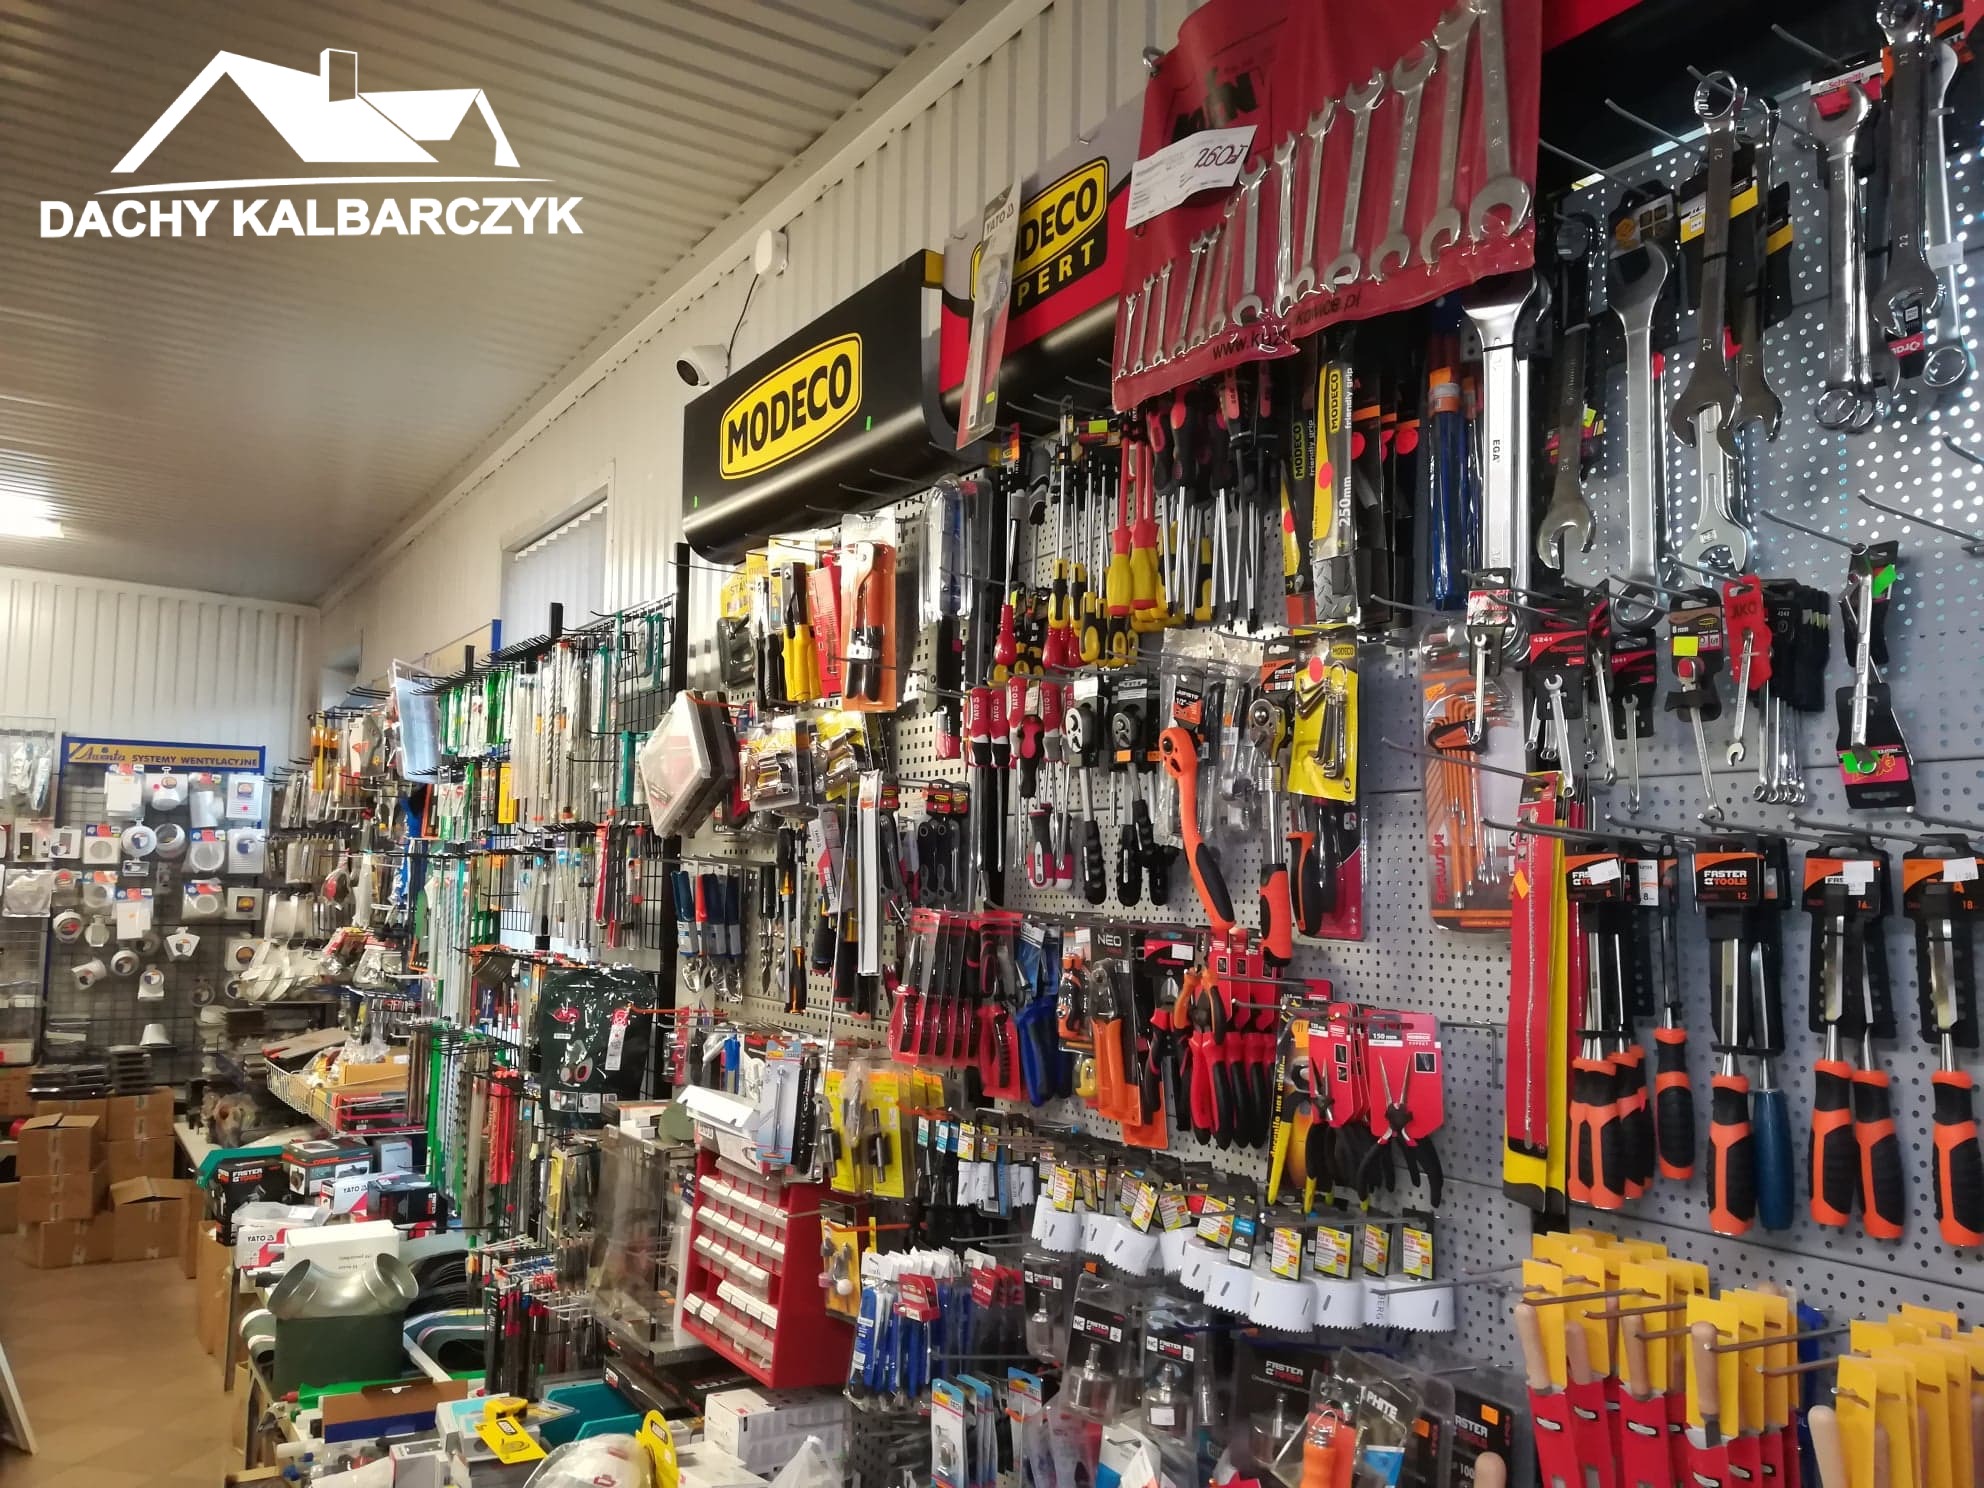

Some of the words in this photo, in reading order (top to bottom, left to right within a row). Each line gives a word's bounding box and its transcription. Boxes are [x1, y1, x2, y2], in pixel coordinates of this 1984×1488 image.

[1020, 177, 1098, 262] DECO
[1017, 238, 1095, 307] PERT
[1345, 367, 1353, 388] grip
[727, 353, 852, 465] MODECO
[1330, 373, 1339, 430] MODECO
[1345, 388, 1353, 429] friendly
[1293, 424, 1304, 478] MODECO
[1492, 439, 1501, 461] EGA
[1338, 475, 1352, 527] 250mm
[131, 754, 177, 764] SYSTEMY
[181, 757, 257, 767] WENTYLACYJNE
[1703, 869, 1747, 878] FASTER
[1713, 878, 1748, 886] TOOLS
[1097, 934, 1122, 947] NEO
[1372, 1032, 1385, 1040] 150
[232, 1168, 263, 1178] FASTER
[343, 1186, 360, 1194] YATO
[247, 1235, 266, 1243] YATO
[1074, 1318, 1085, 1329] NC
[1265, 1360, 1304, 1376] FASTER
[1366, 1391, 1399, 1420] PHITE
[1455, 1415, 1488, 1438] ASTER
